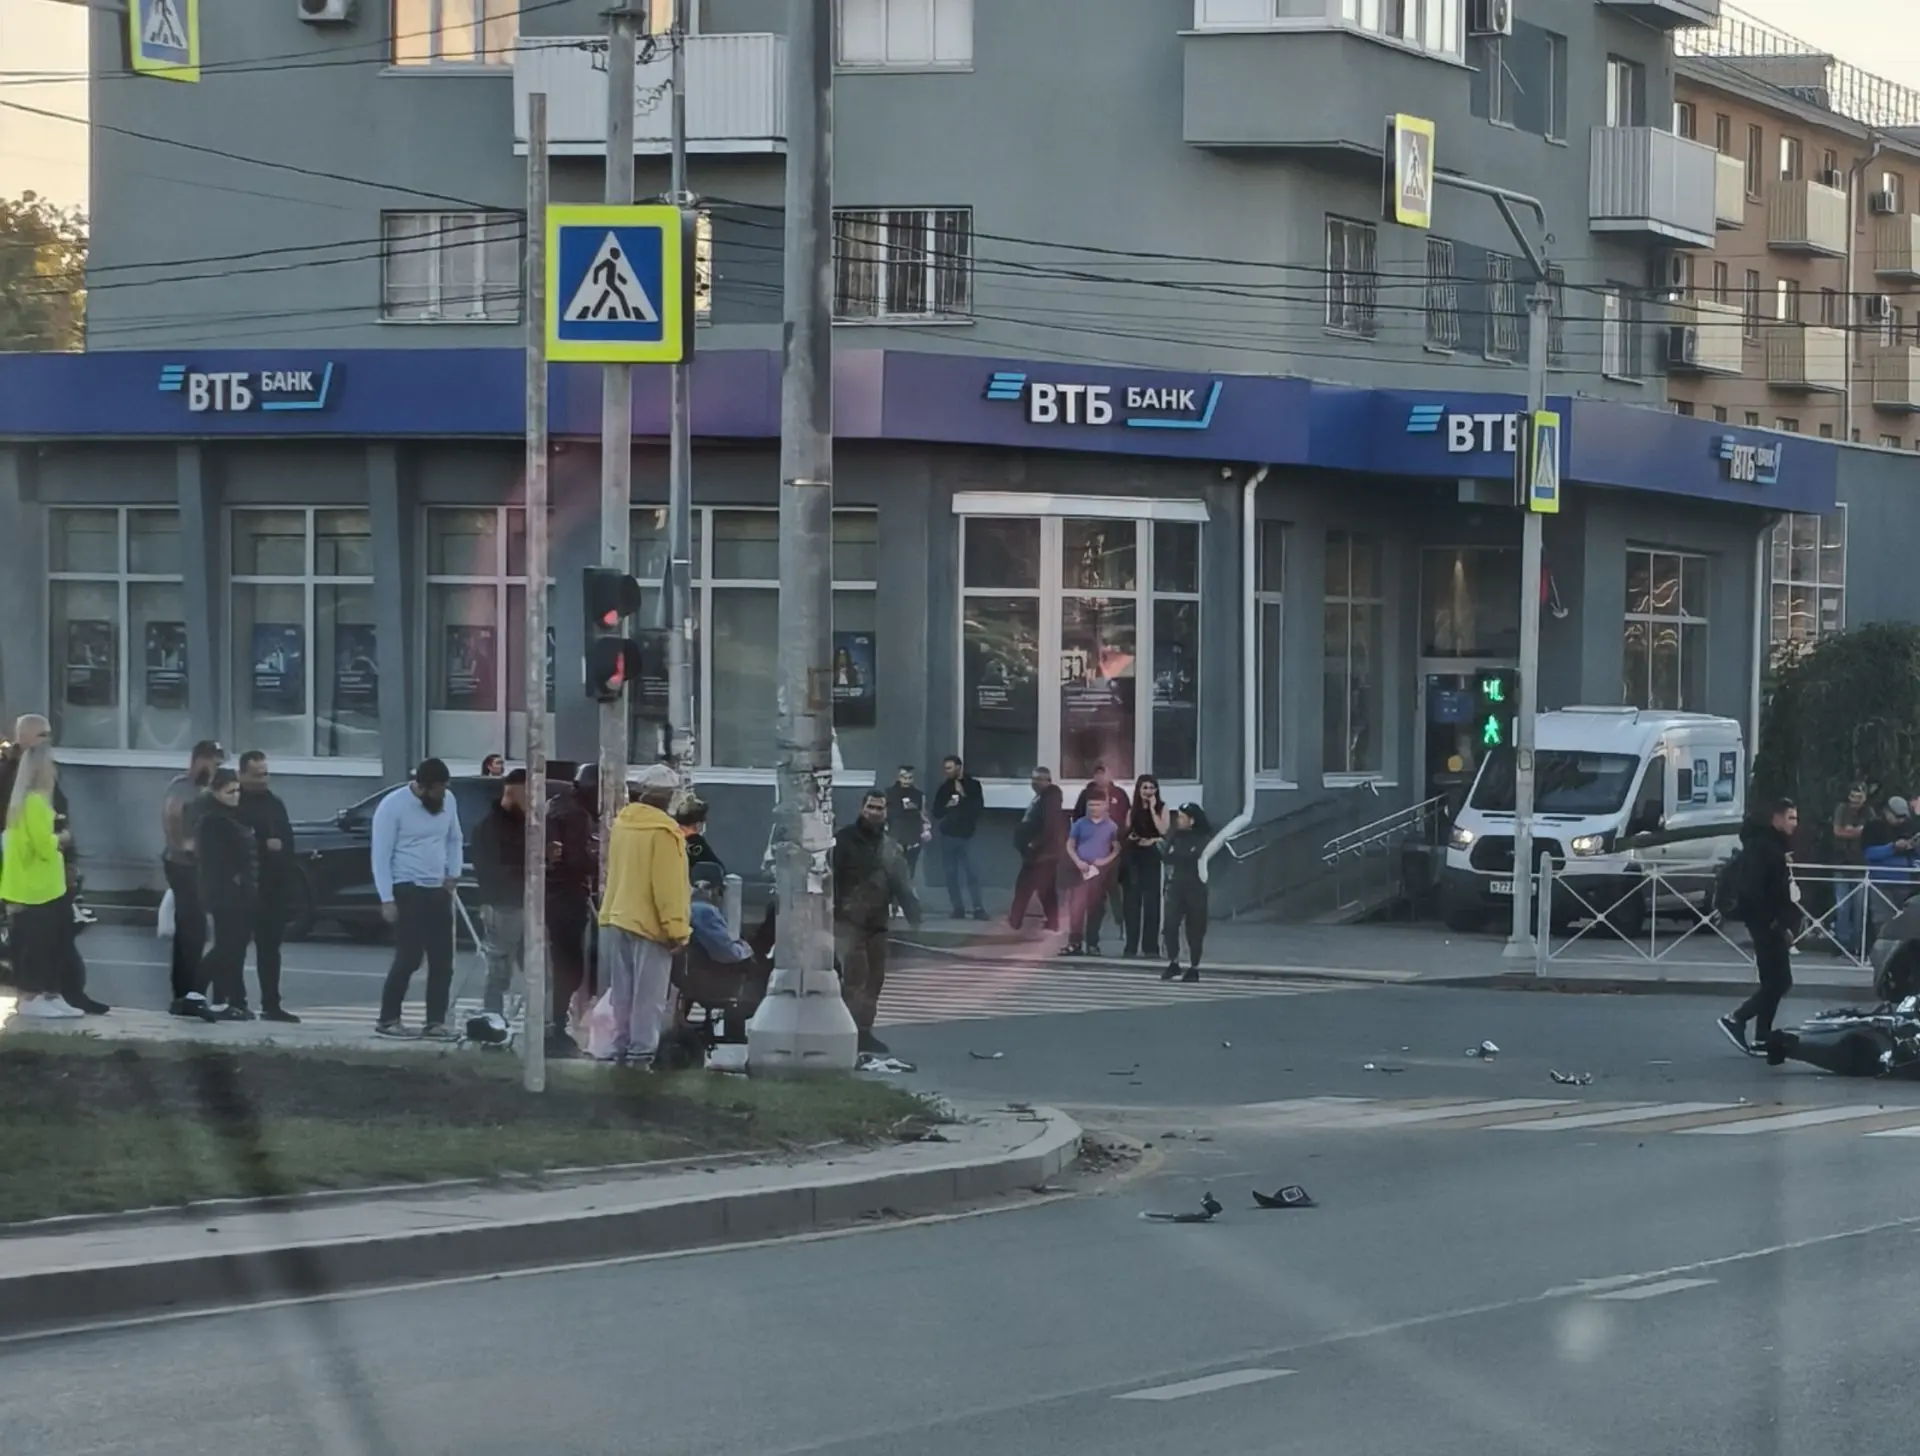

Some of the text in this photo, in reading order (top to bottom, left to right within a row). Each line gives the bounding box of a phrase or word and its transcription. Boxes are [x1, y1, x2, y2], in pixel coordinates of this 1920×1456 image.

[188, 370, 313, 411] ВТБ БАНК
[1030, 382, 1196, 425] ВТБ БАНК
